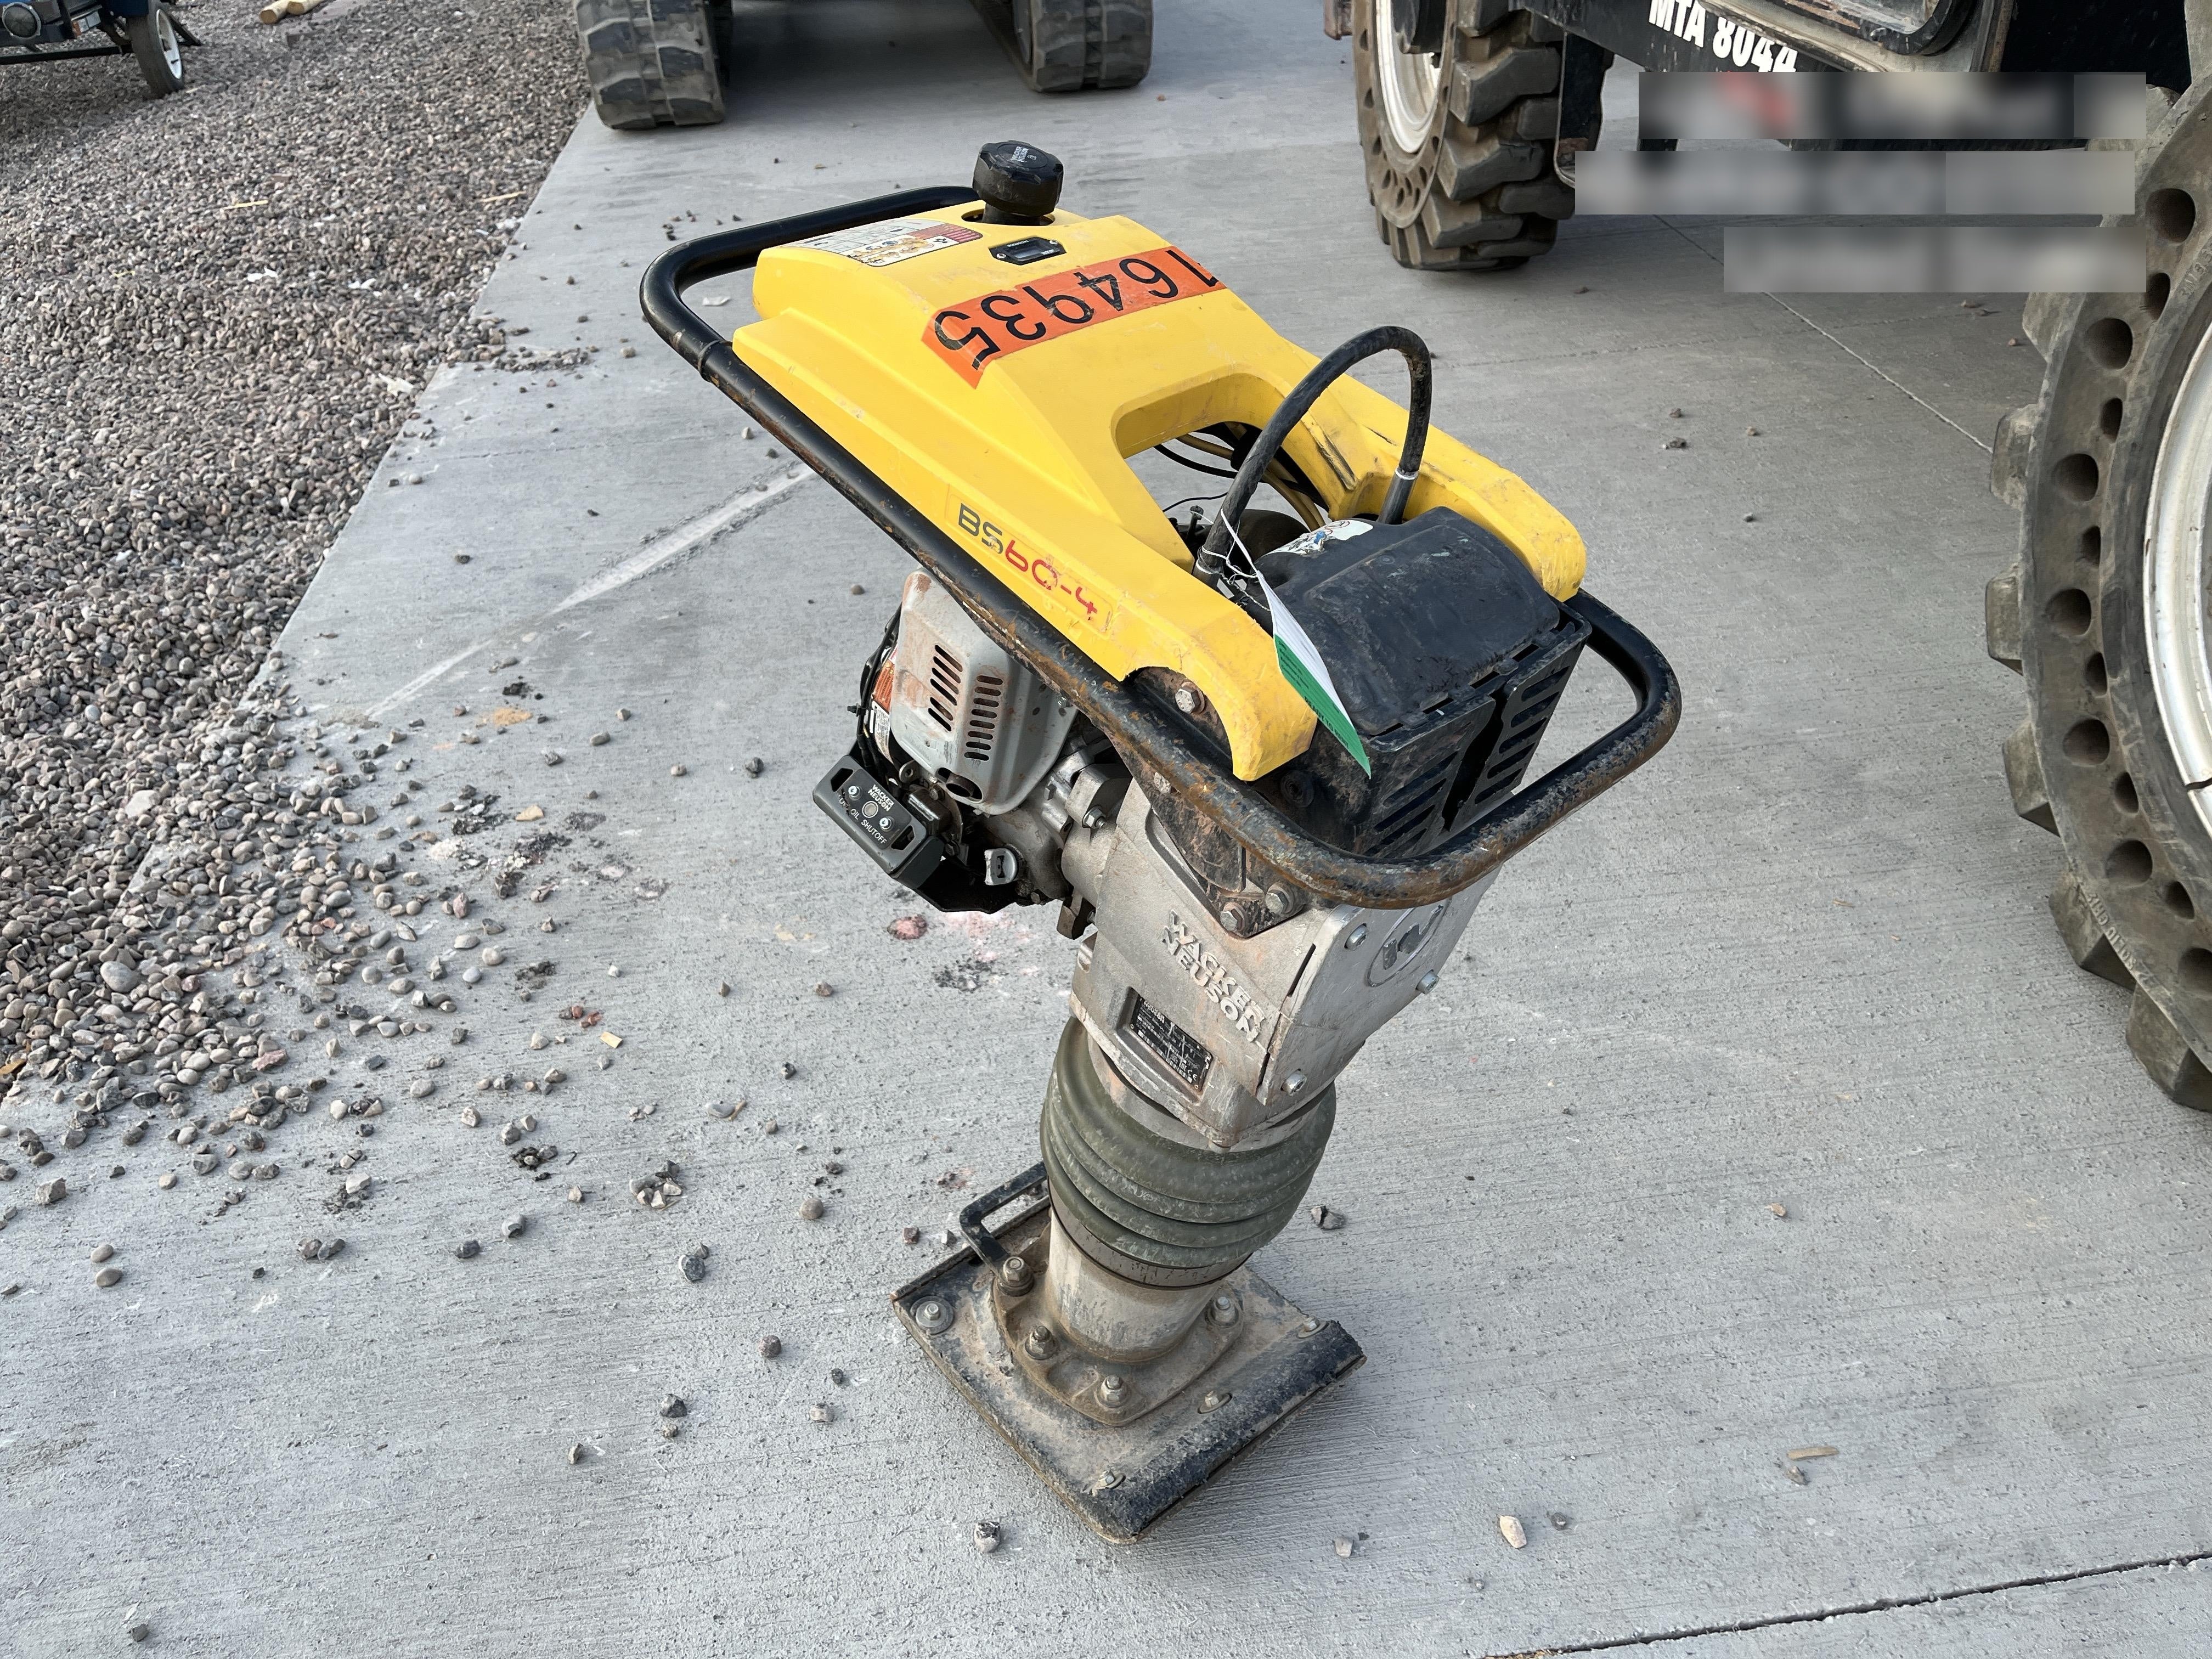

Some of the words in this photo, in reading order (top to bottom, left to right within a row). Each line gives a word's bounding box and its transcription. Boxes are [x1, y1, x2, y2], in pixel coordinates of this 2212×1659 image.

[1649, 0, 1706, 48] MTA
[1712, 17, 1798, 72] 8044
[934, 250, 1218, 370] 164935
[850, 809, 860, 820] OIL
[861, 820, 887, 844] SHUTOFF
[868, 789, 890, 812] NEUSON
[871, 785, 894, 806] WACKER
[1162, 926, 1259, 1042] NEUSON
[1168, 909, 1265, 1031] WACKER
